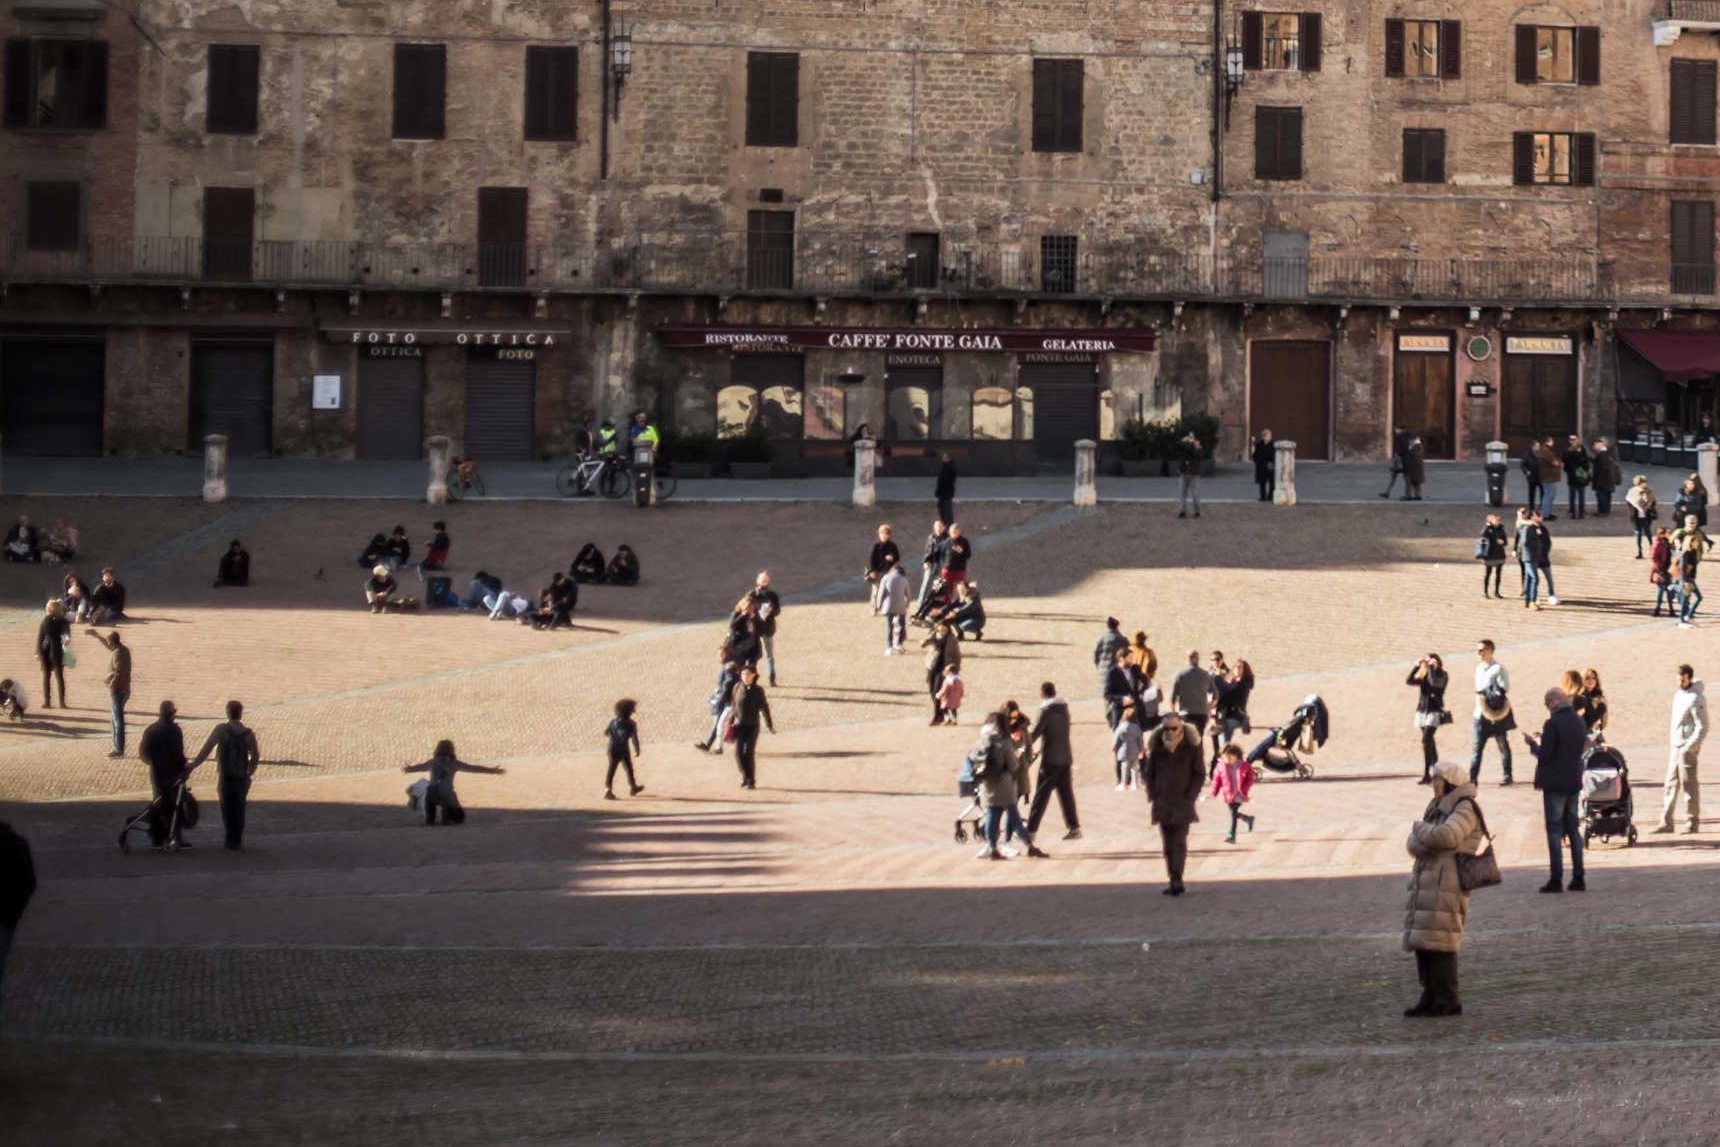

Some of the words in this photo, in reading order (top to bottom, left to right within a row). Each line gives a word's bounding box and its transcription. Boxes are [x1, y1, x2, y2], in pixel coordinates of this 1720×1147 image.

[353, 333, 416, 344] FOTO
[457, 334, 555, 345] OTTICA
[705, 334, 789, 344] RISTORANTE
[828, 334, 891, 347] CAFFE'
[895, 334, 954, 348] FONTE
[958, 335, 1003, 349] GAIA
[1042, 339, 1117, 350] GELATERIA
[370, 346, 422, 357] OTTICA
[498, 349, 535, 359] FOTO
[888, 354, 941, 365] ENOTECA
